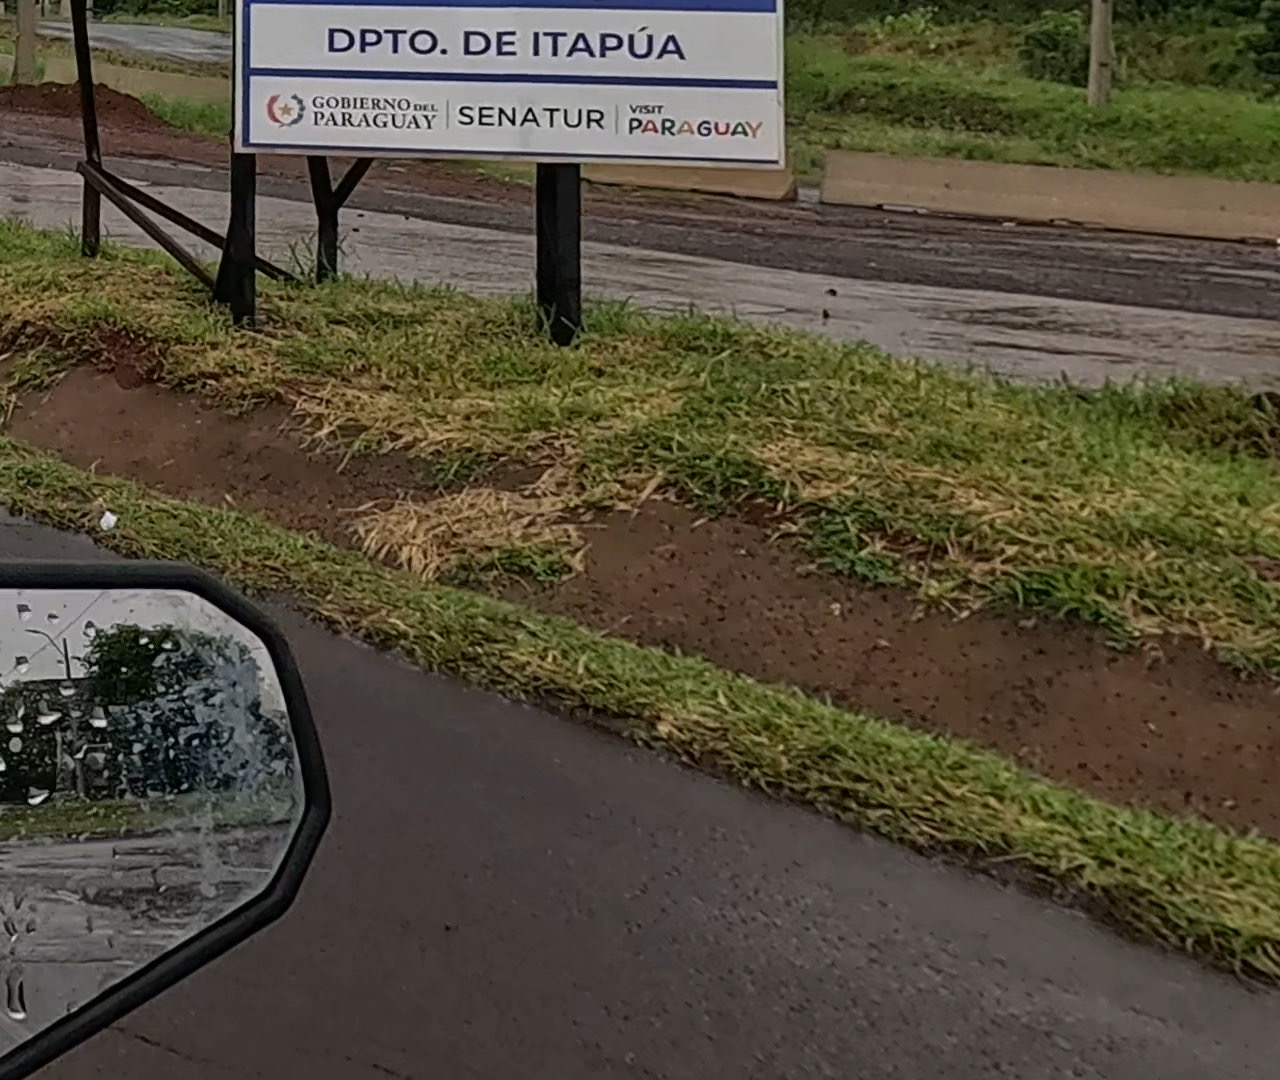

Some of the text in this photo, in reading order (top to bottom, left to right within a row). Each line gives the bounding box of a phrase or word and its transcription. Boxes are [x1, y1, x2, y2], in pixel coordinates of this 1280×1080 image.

[327, 27, 686, 61] DPTO. DE ITAPÚA
[312, 96, 438, 112] GOBIERNO DEL
[629, 104, 664, 114] VISIT
[313, 111, 438, 129] PARAGUAY
[458, 106, 605, 129] SENATUR
[629, 119, 764, 138] PARAGUAY
